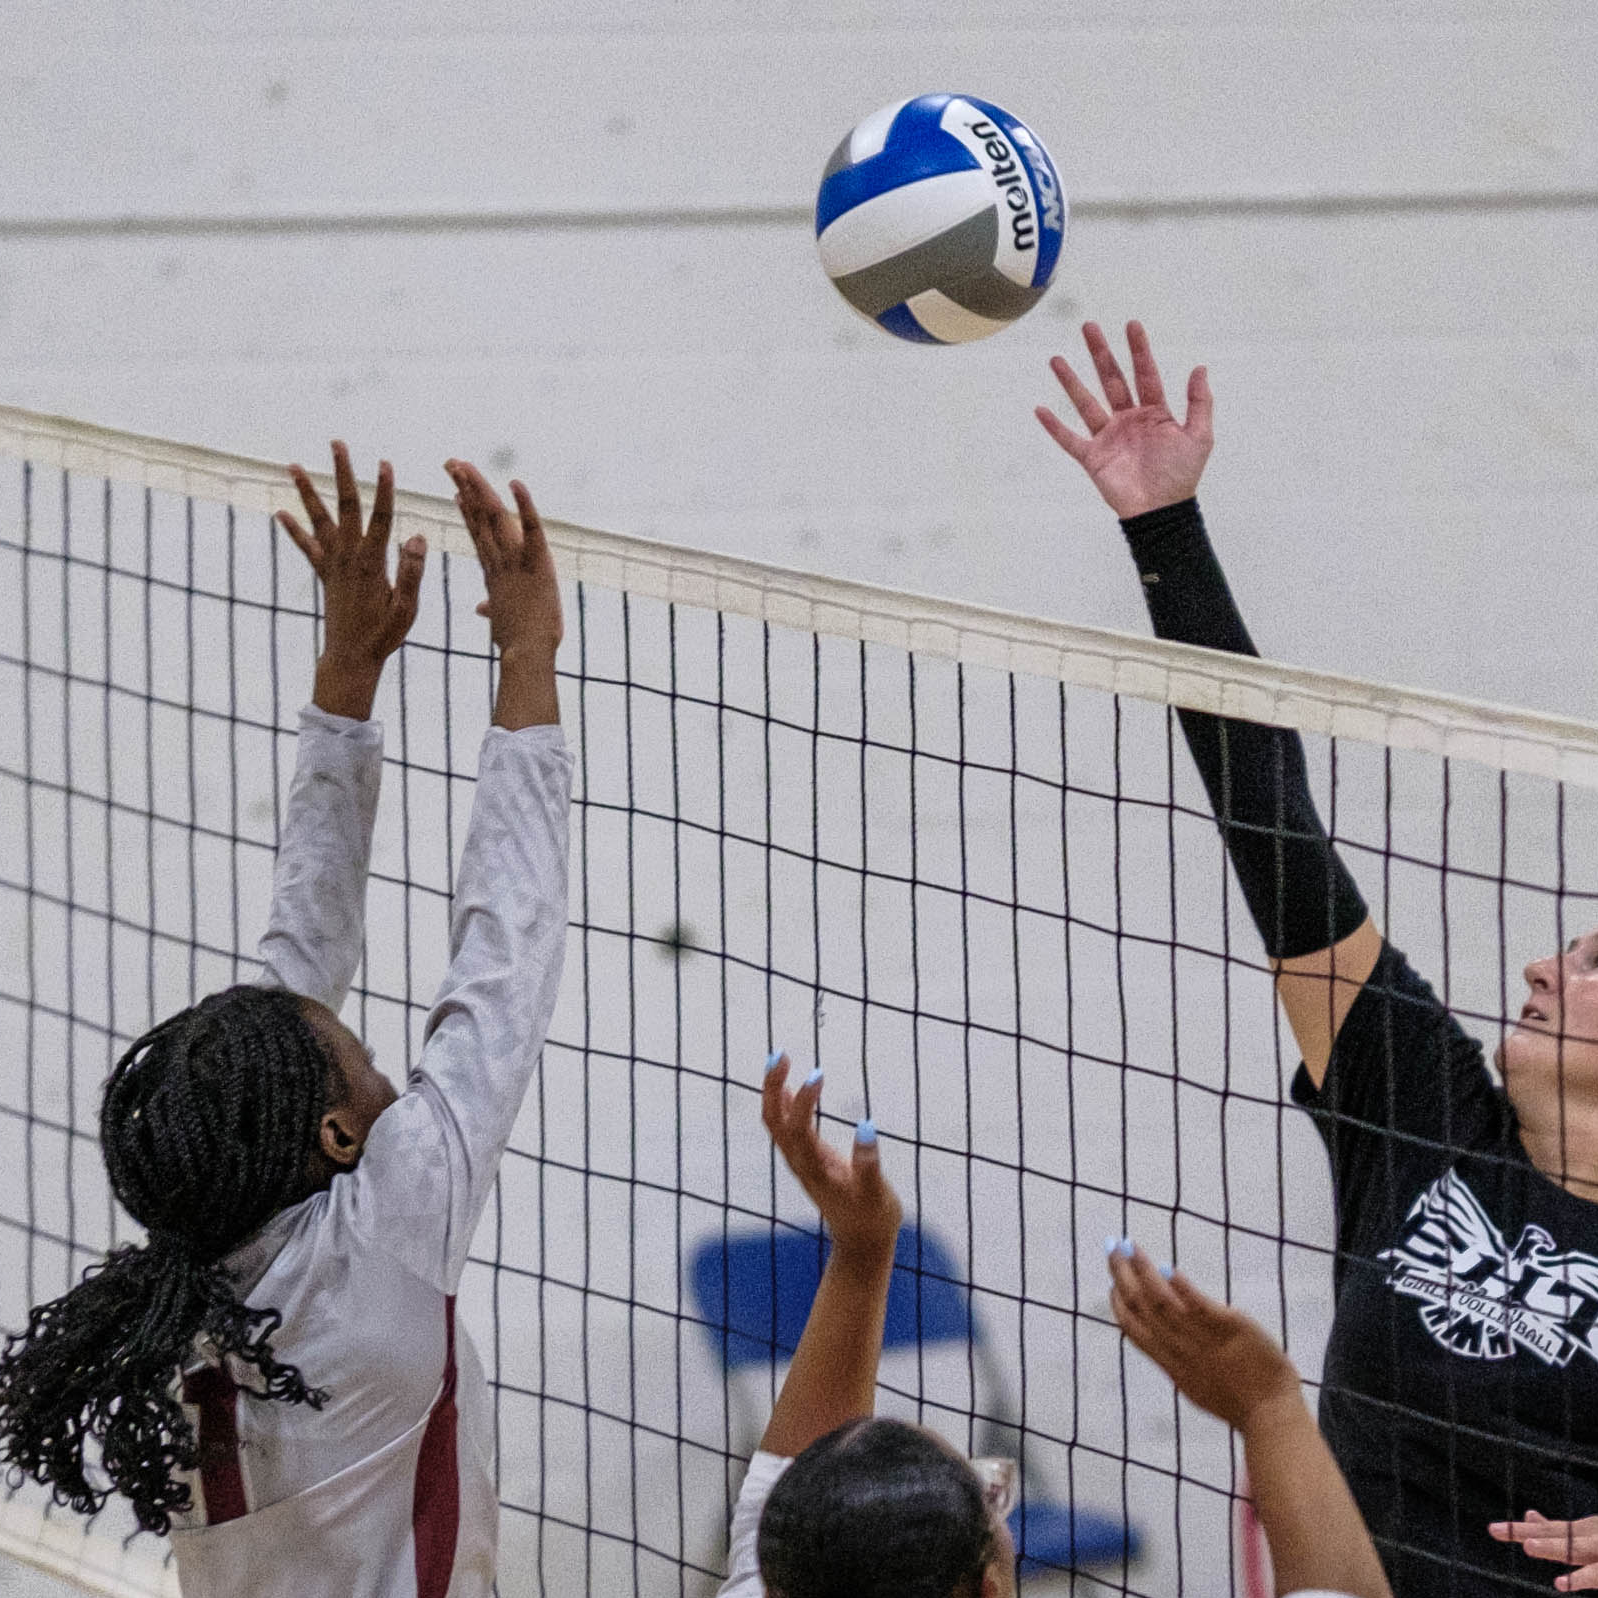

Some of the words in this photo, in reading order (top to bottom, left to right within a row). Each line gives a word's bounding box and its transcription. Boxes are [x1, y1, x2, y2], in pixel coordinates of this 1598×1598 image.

[970, 120, 1035, 252] molten
[1402, 1275, 1451, 1300] GIRLS
[1458, 1293, 1554, 1355] VOLLEYBALL
